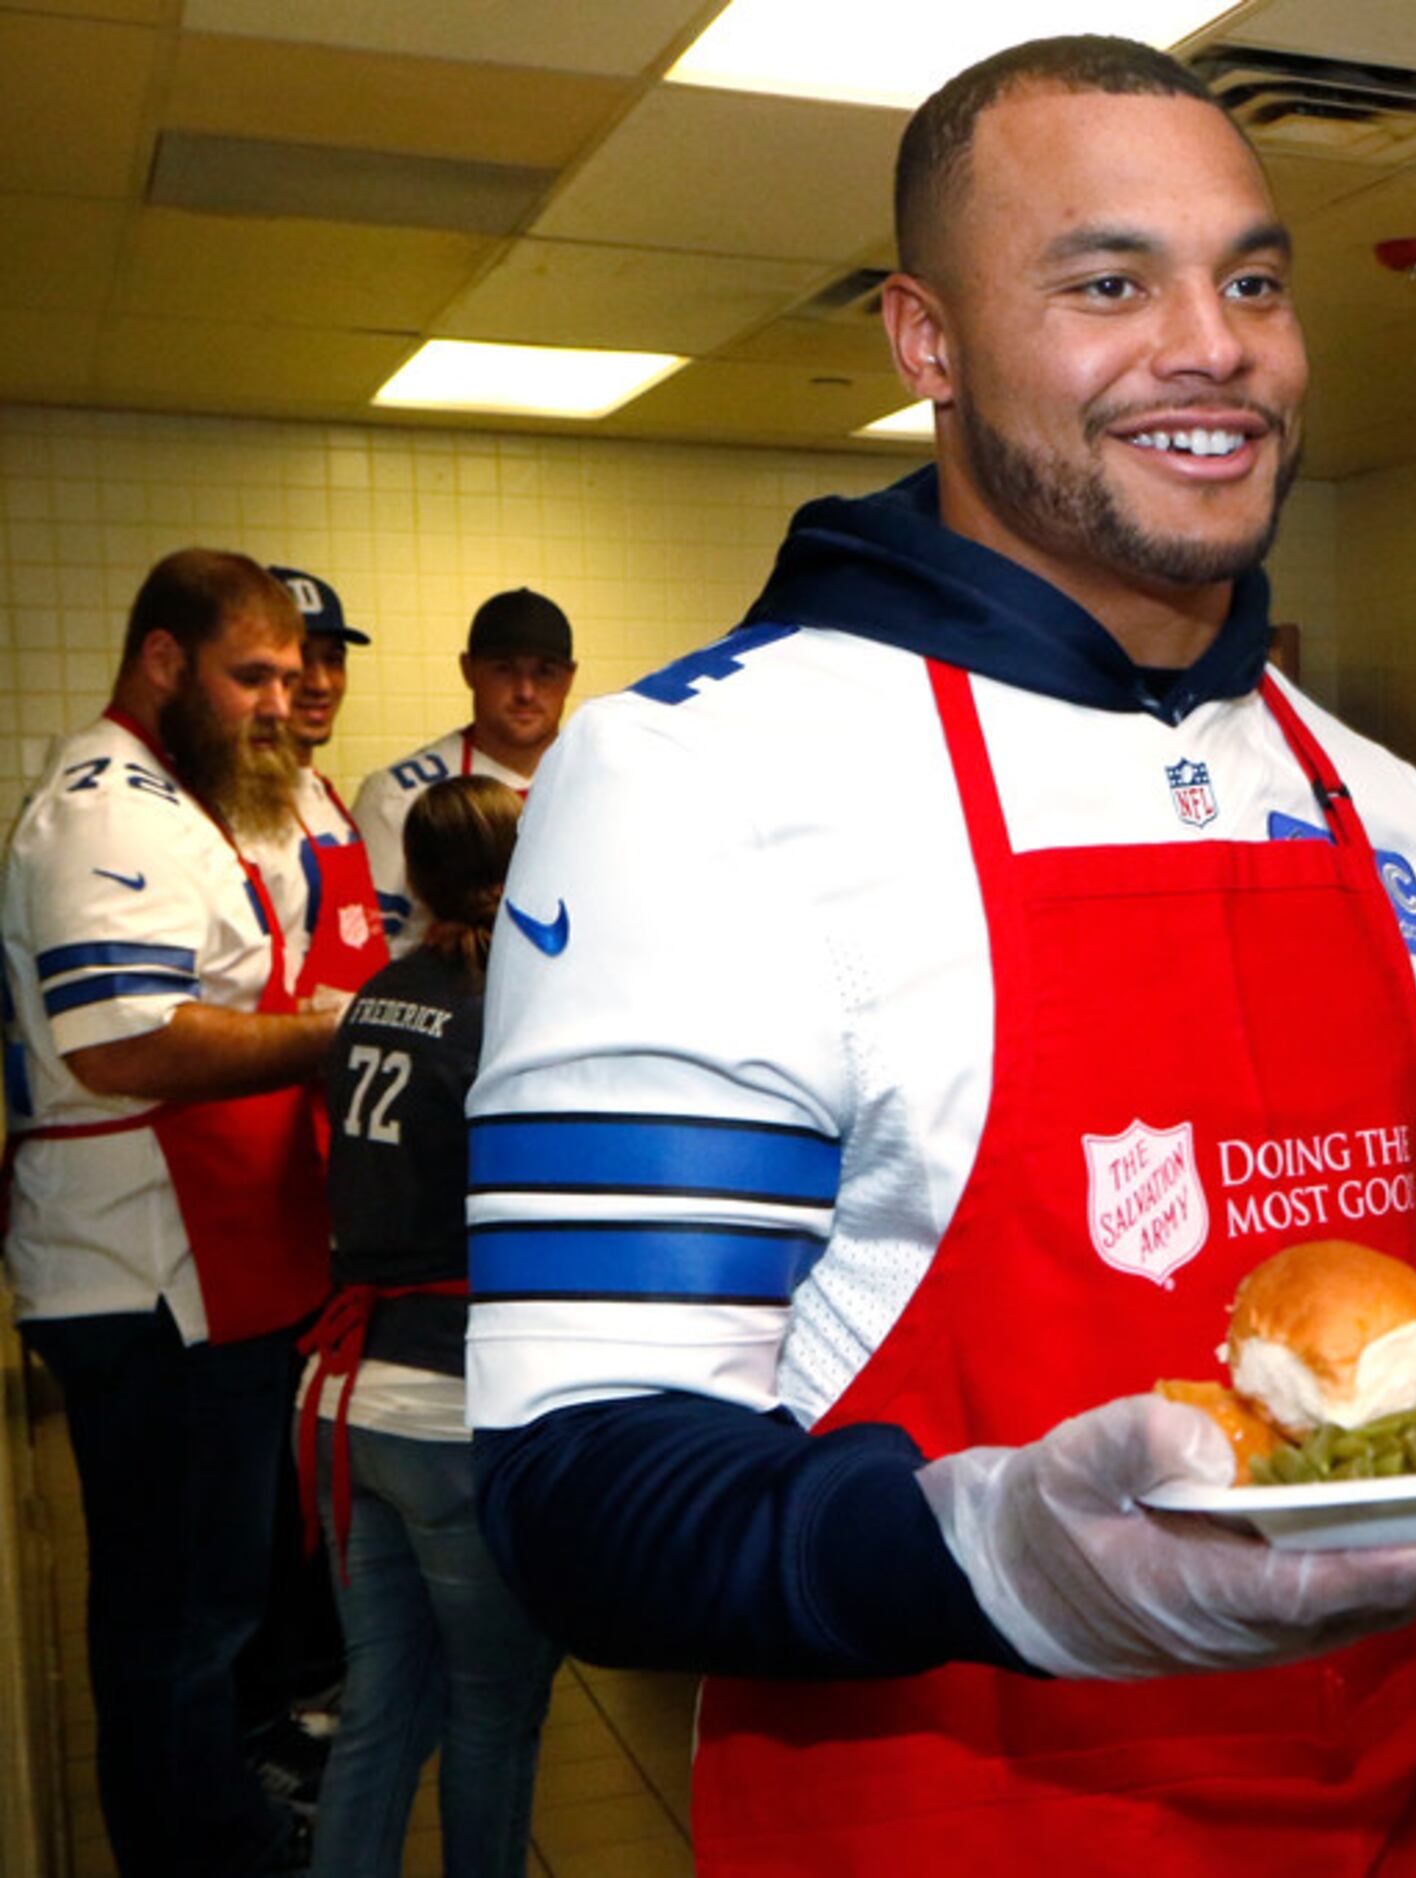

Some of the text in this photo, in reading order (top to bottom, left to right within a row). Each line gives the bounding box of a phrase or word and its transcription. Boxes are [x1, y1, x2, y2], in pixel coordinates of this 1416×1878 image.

[1174, 787, 1214, 820] NFL
[350, 998, 453, 1038] FREDERICK
[343, 1044, 412, 1146] 72
[1110, 1139, 1149, 1192] THE
[1218, 1132, 1350, 1187] DOING
[1100, 1141, 1186, 1248] SALVATION
[1227, 1184, 1328, 1238] MOST
[1140, 1184, 1188, 1263] ARMY
